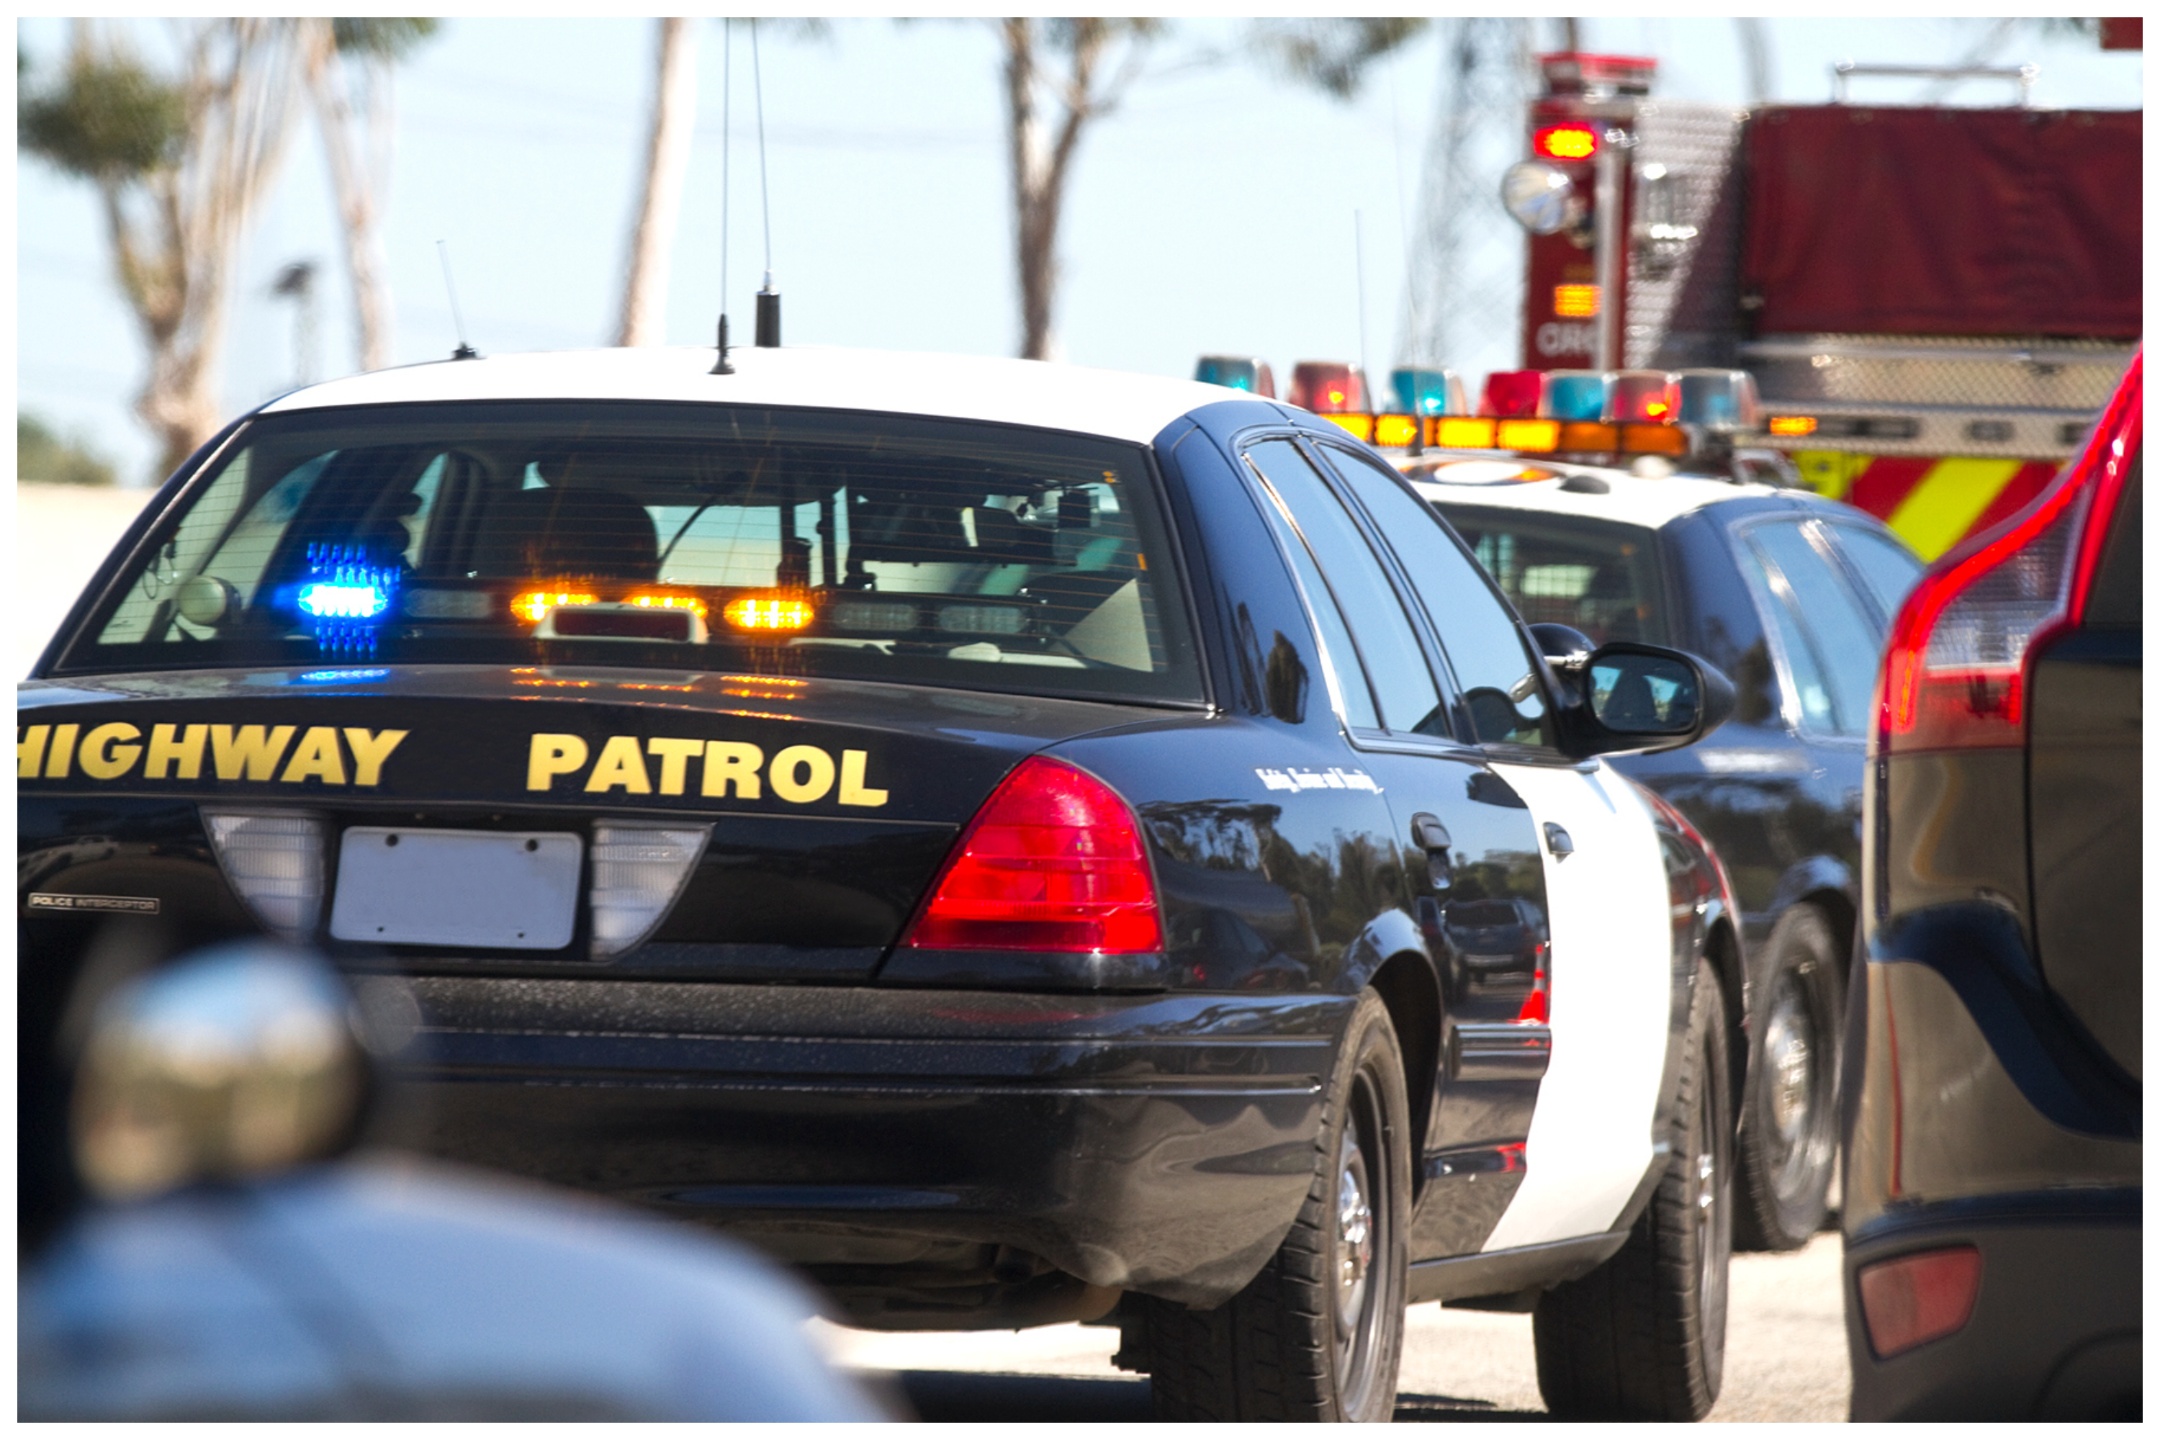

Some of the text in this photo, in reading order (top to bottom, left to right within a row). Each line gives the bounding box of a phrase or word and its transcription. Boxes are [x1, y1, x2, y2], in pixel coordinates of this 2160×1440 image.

[17, 723, 889, 807] HIGHWAY PATROL
[32, 896, 156, 910] POLICE INTERCEPTOR
